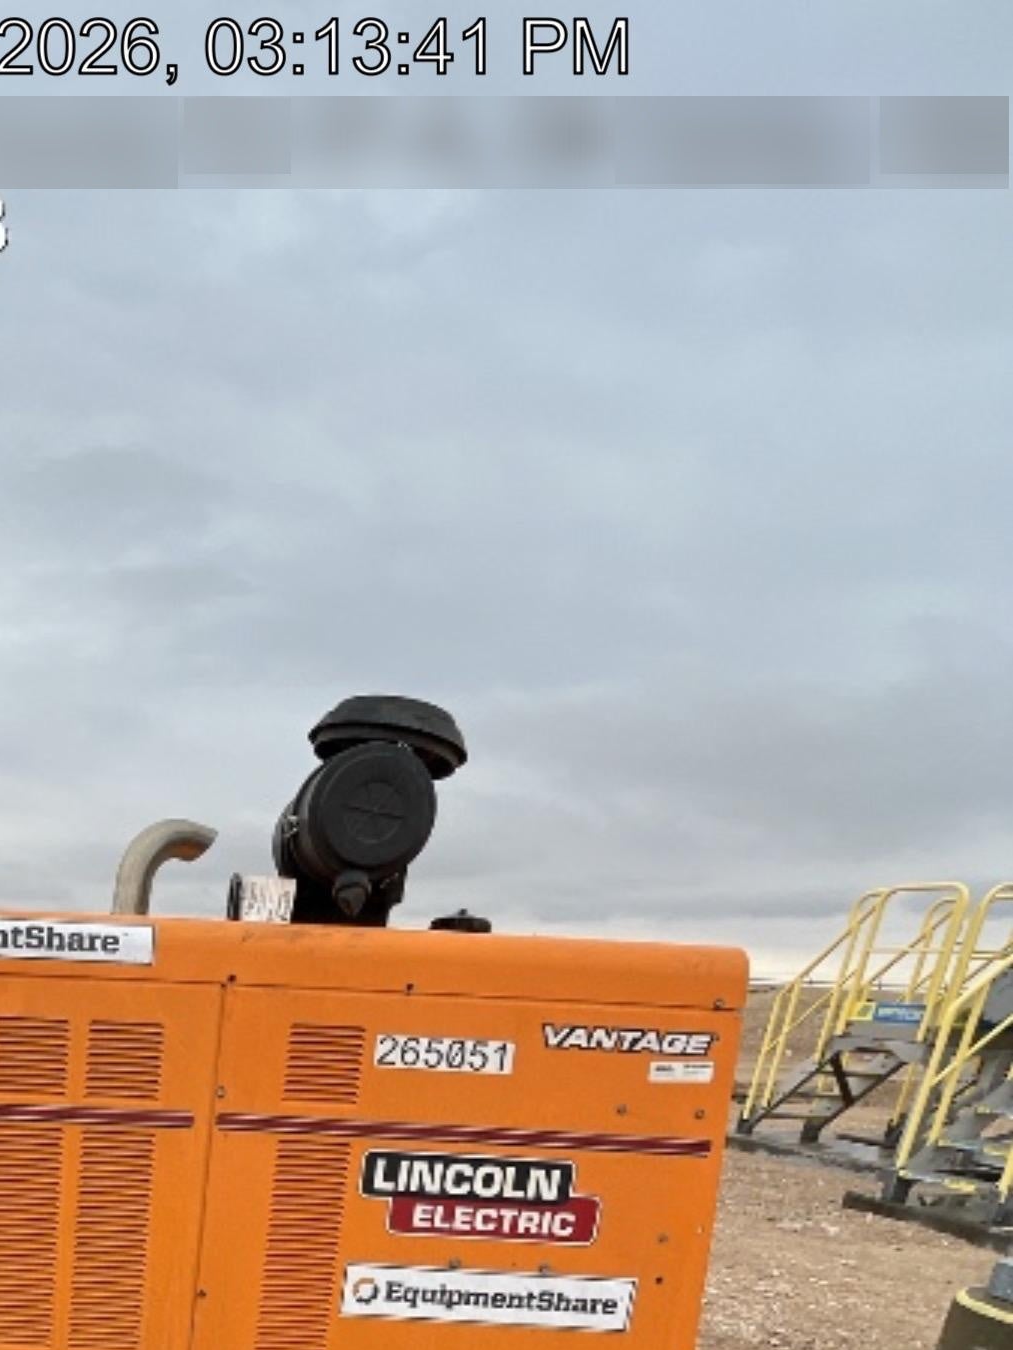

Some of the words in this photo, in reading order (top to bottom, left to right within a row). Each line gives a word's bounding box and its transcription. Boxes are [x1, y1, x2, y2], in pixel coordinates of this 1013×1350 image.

[376, 1035, 509, 1072] 265051
[542, 1024, 714, 1056] VANTAGE
[372, 1158, 562, 1200] LINCOLN
[412, 1203, 577, 1237] ELECTRIC
[385, 1280, 619, 1316] EquipmentShare
